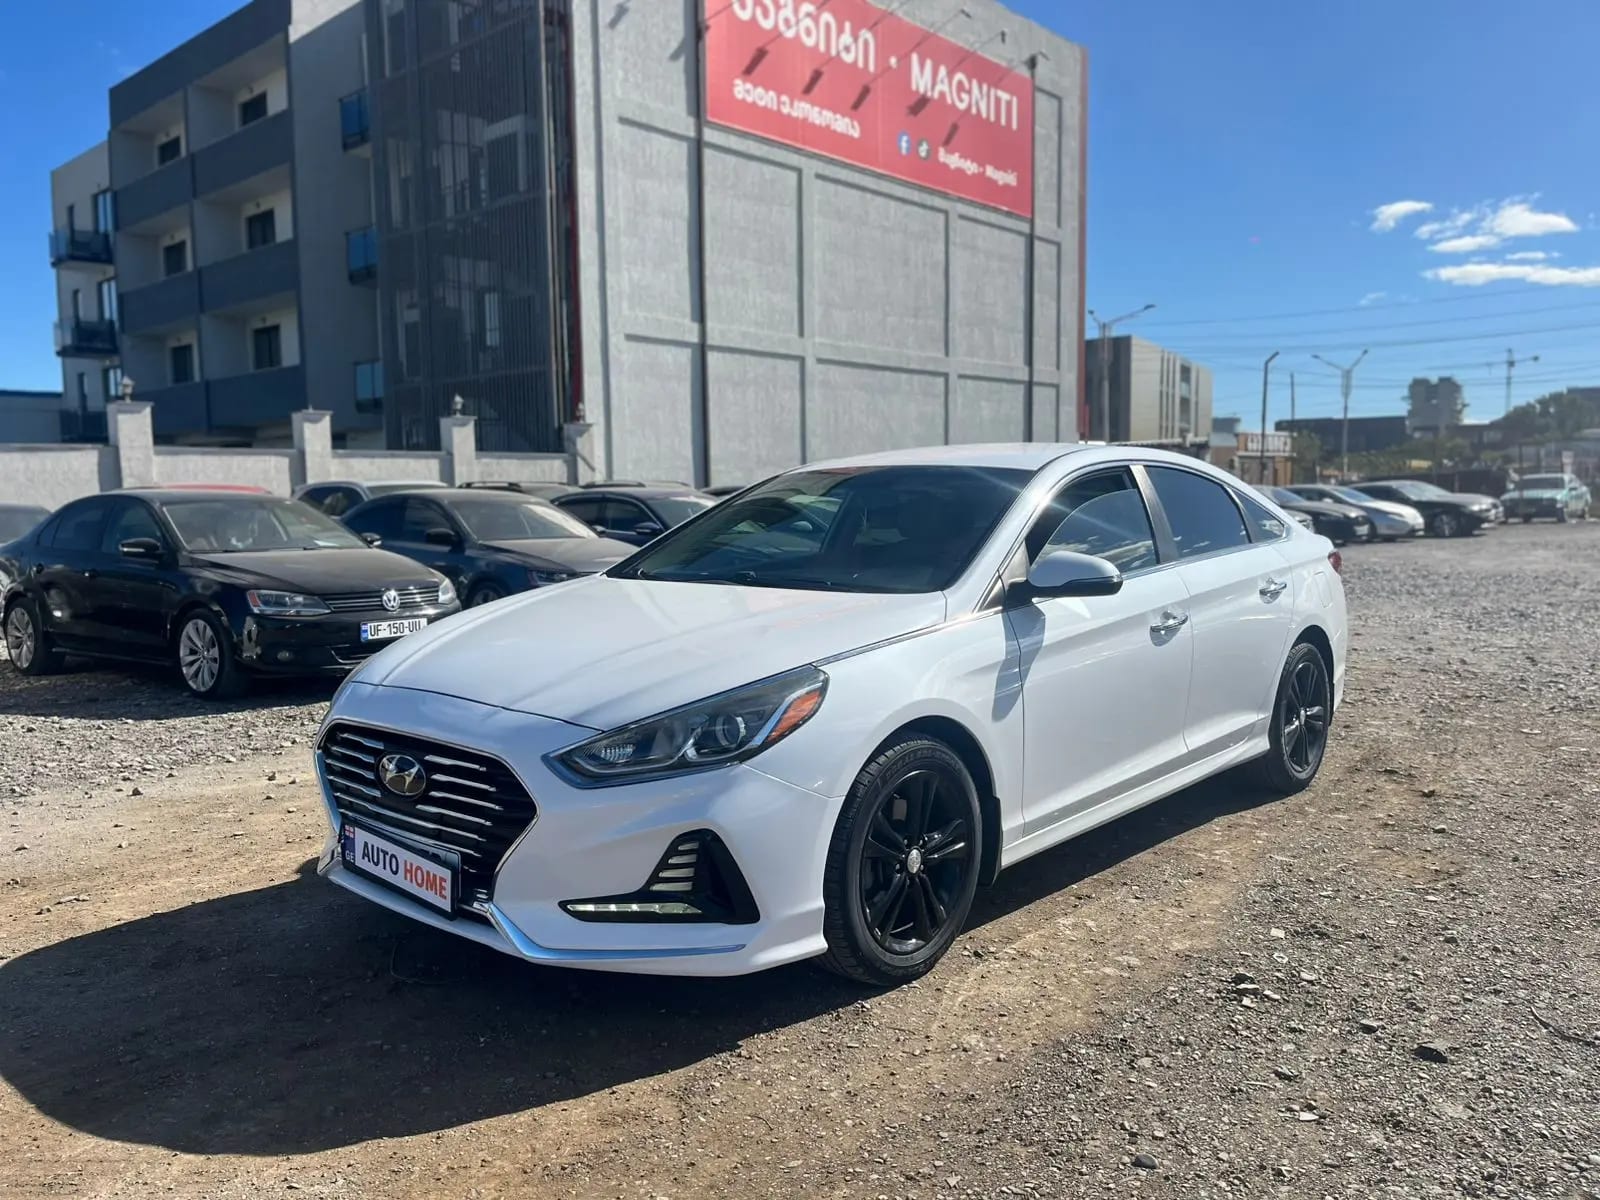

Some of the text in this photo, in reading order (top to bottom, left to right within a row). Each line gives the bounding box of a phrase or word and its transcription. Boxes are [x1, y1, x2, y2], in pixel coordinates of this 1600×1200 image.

[911, 52, 1018, 130] MAGNITI
[361, 841, 447, 900] AUTO HOME
